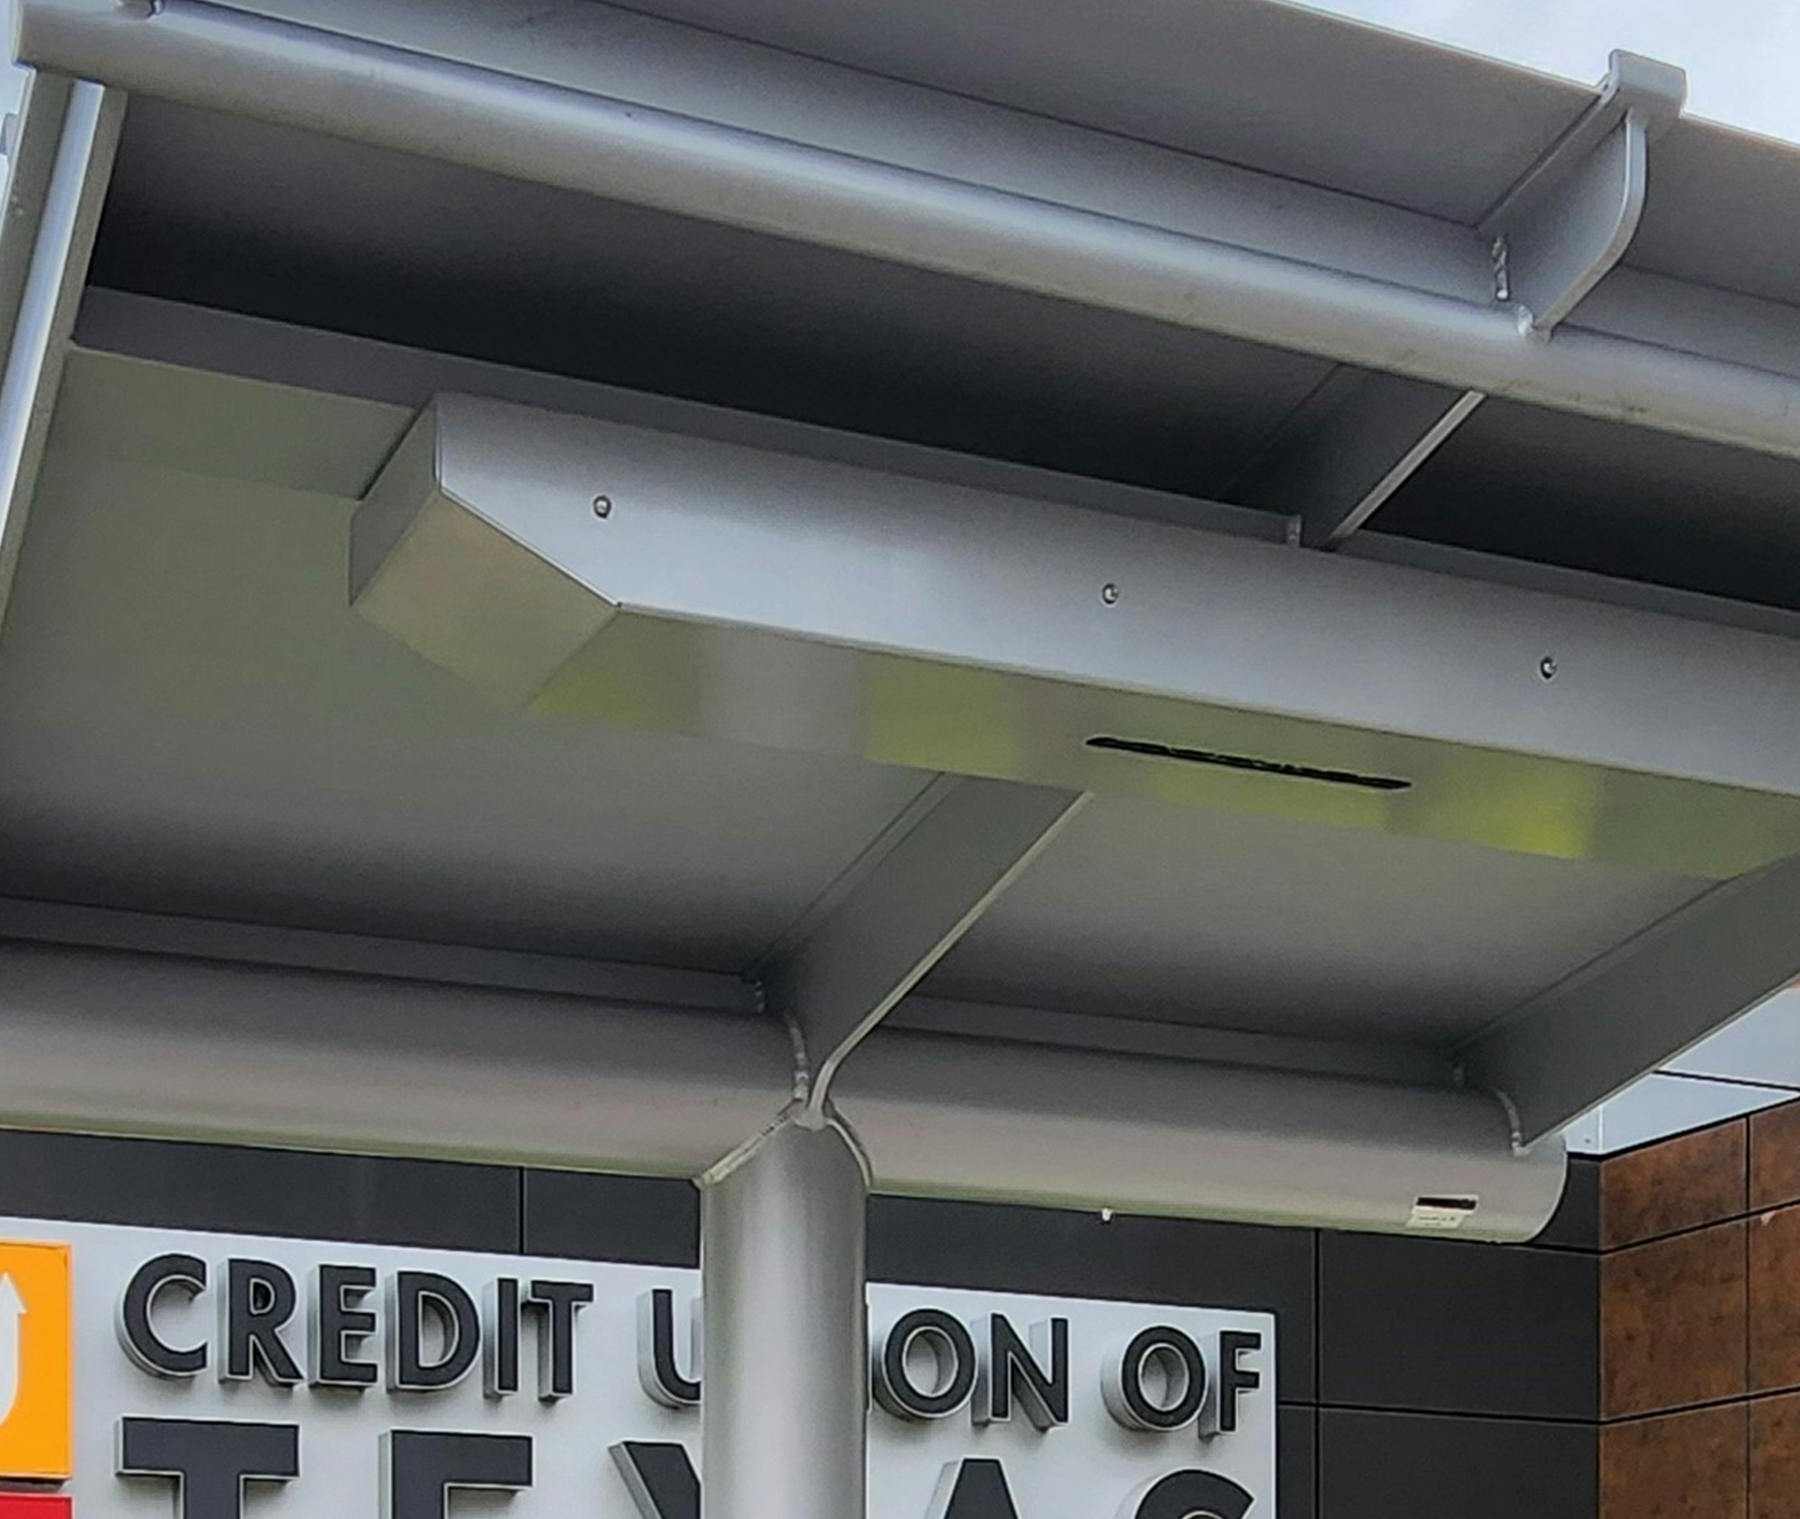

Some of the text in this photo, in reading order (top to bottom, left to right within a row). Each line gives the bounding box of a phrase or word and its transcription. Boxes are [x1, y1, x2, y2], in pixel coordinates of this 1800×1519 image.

[115, 1252, 1262, 1438] CREDIT UON OF
